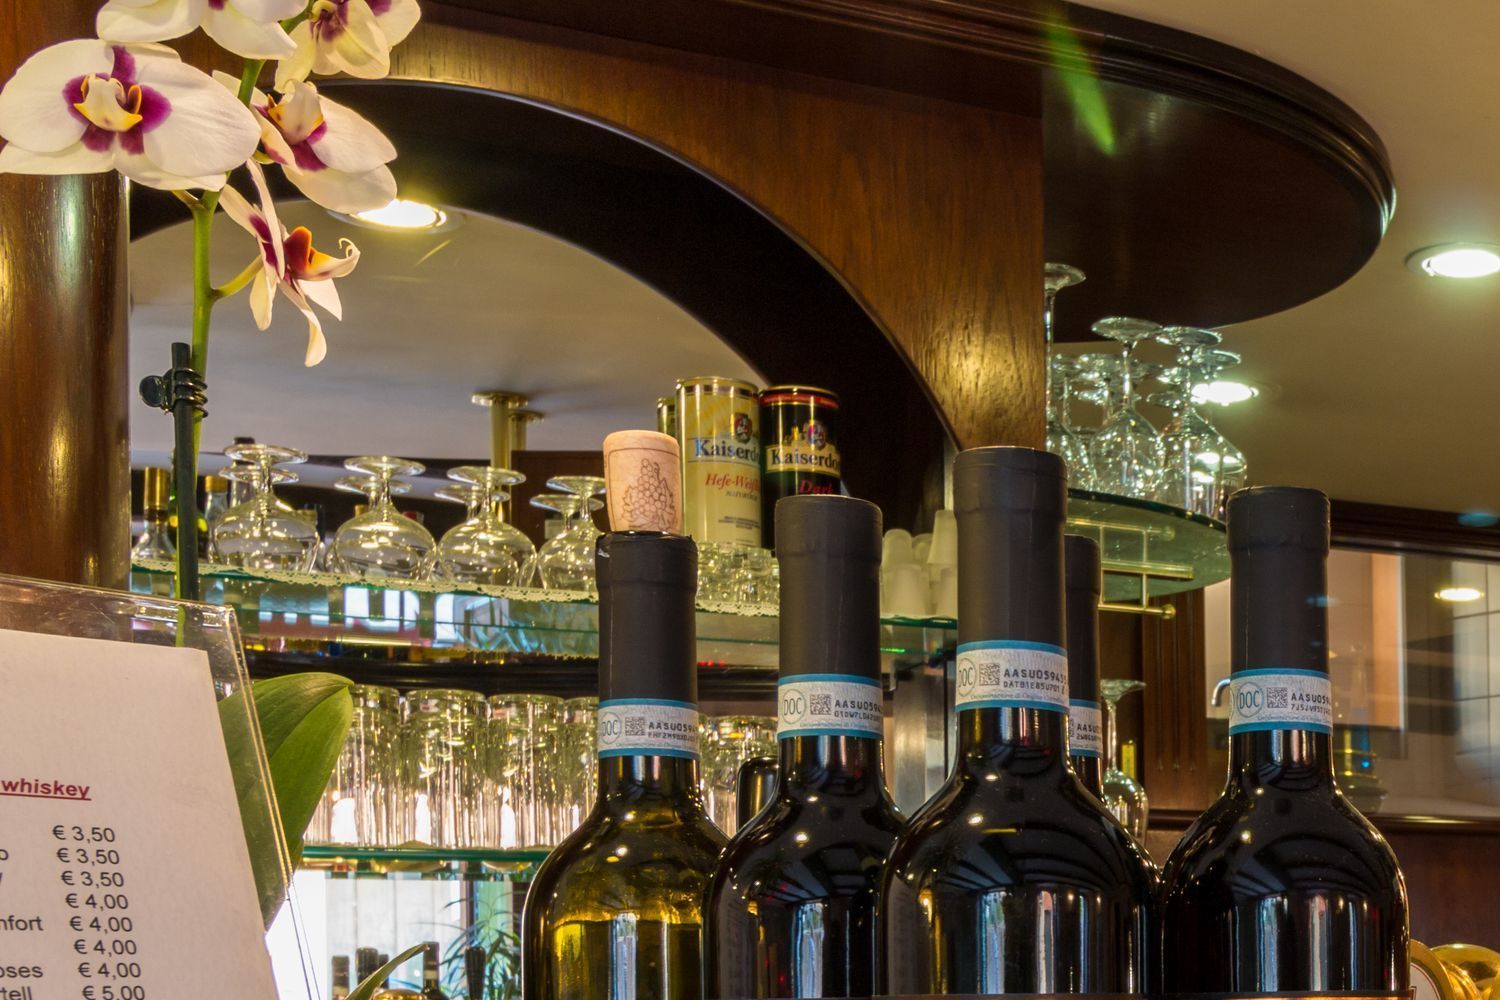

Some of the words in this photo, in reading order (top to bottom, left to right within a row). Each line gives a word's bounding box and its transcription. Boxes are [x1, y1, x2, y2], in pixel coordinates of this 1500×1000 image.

[782, 697, 802, 716] DOC
[1239, 690, 1260, 710] DOC
[2, 778, 90, 800] whiskey
[52, 825, 67, 841] €
[72, 826, 116, 844] 3,50
[57, 847, 71, 863] €
[76, 848, 120, 866] 3,50
[61, 870, 76, 886] €
[80, 871, 125, 888] 3,50
[65, 893, 80, 908] €
[85, 894, 129, 911] 4,00
[69, 916, 84, 931] €
[89, 917, 133, 934] 4,00
[73, 939, 88, 955] €
[93, 940, 137, 957] 4,00
[78, 962, 92, 978] €
[98, 962, 141, 980] 4,00
[82, 985, 97, 1000] €
